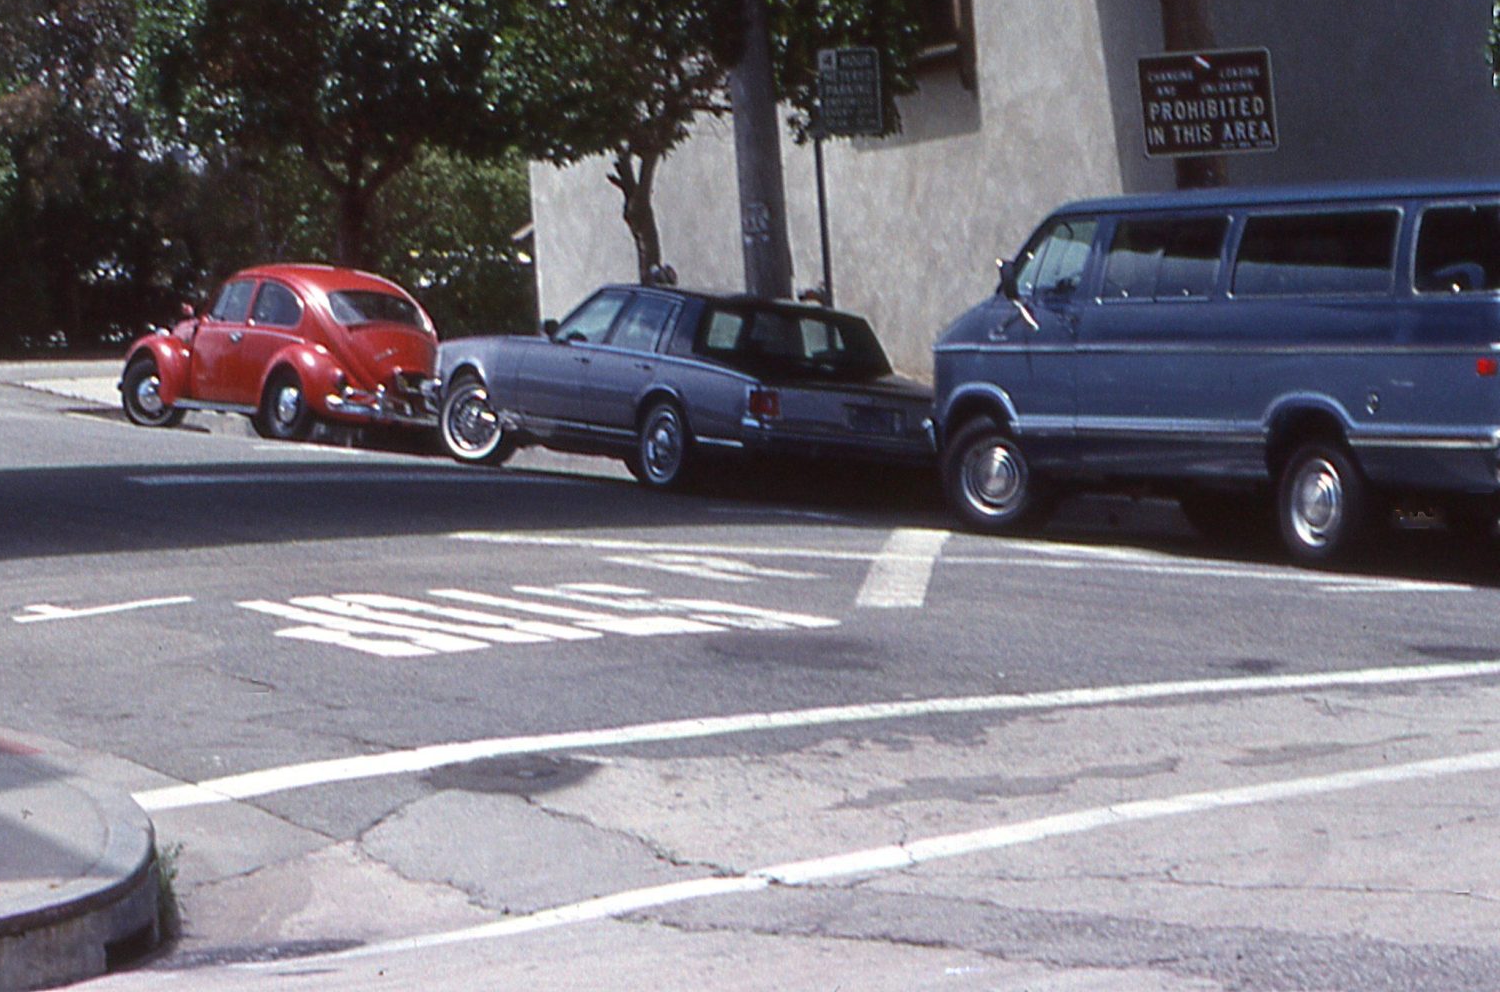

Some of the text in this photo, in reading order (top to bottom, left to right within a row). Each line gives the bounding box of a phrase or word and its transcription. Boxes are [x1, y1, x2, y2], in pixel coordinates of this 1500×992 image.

[1149, 95, 1266, 121] PROHIBITED
[1146, 120, 1272, 145] IN THIS AREA
